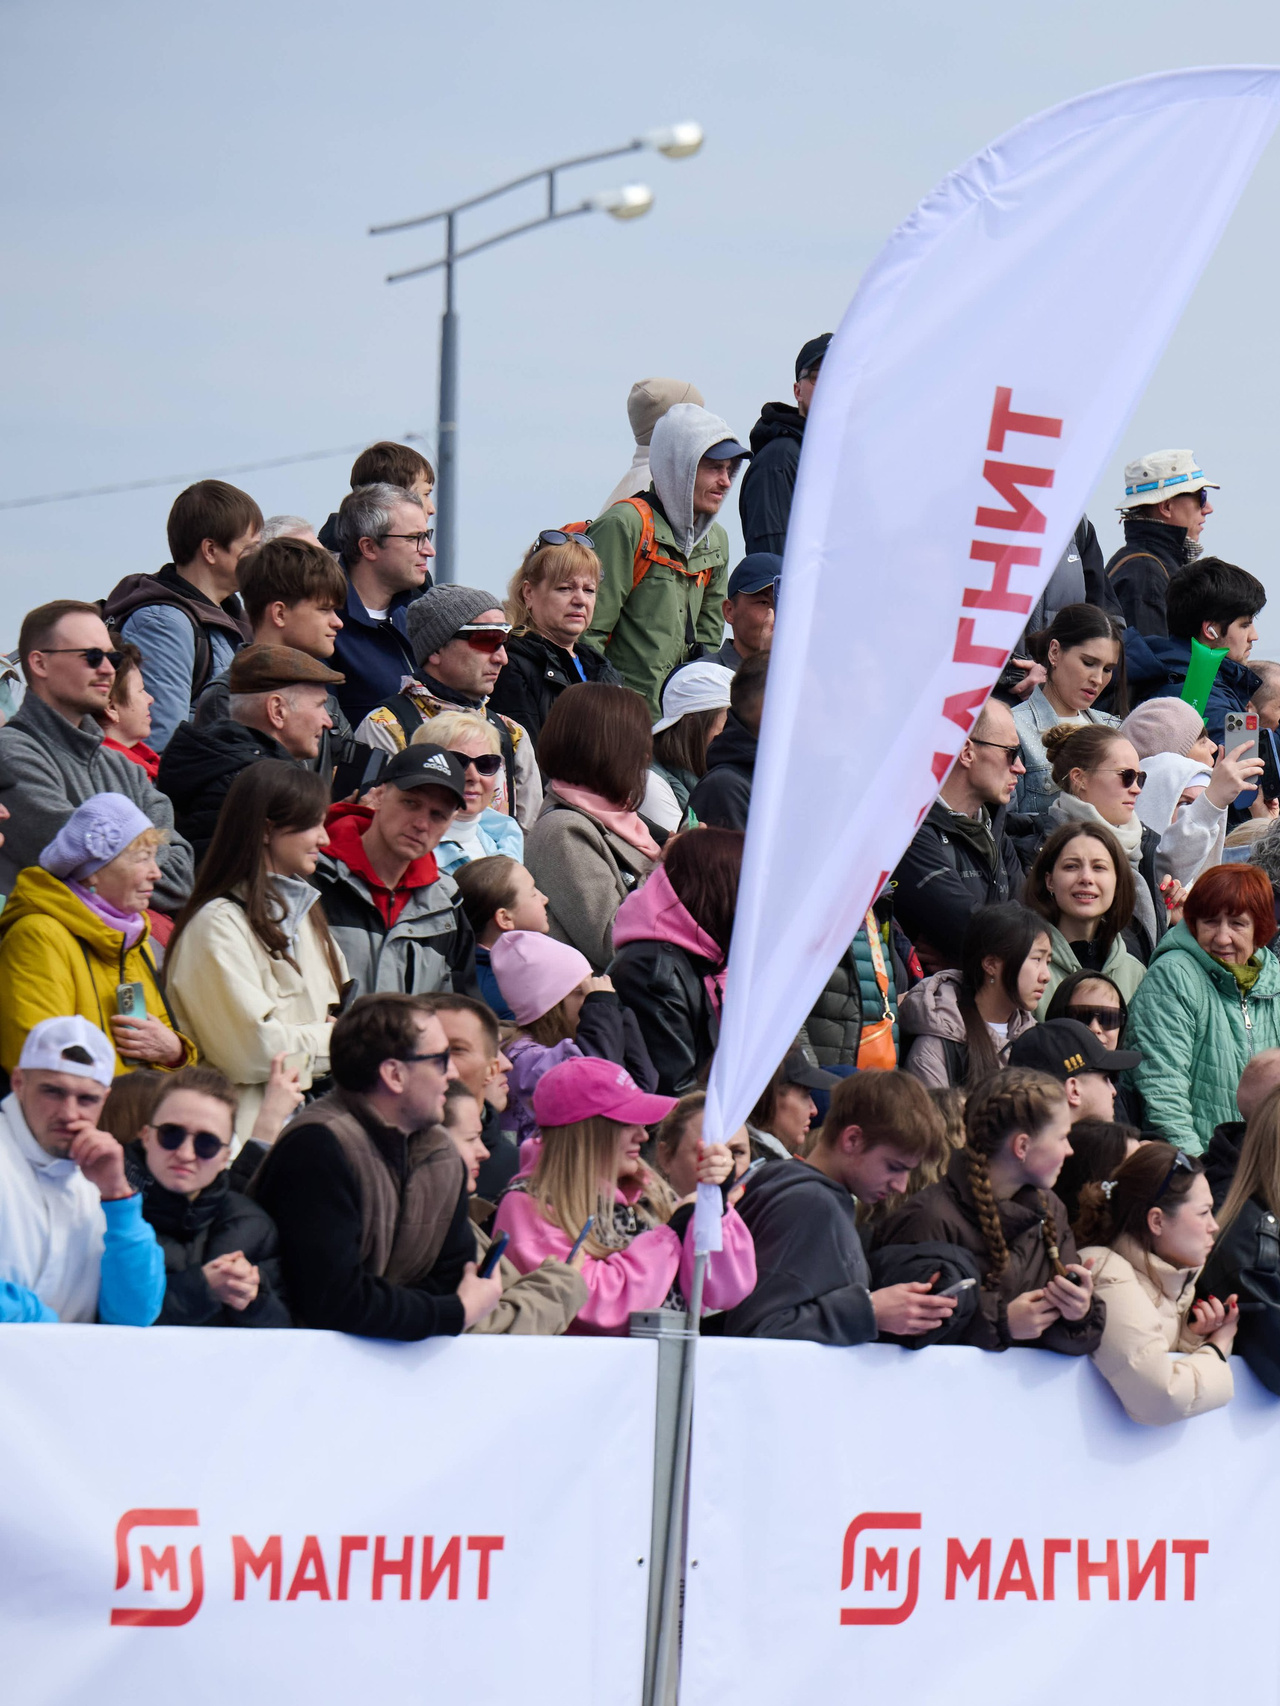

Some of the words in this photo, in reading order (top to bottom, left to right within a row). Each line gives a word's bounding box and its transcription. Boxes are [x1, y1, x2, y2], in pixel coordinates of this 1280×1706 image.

[423, 762, 452, 776] adidas
[231, 1535, 505, 1601] МАГНИТ
[944, 1537, 1210, 1601] МАГНИТ
